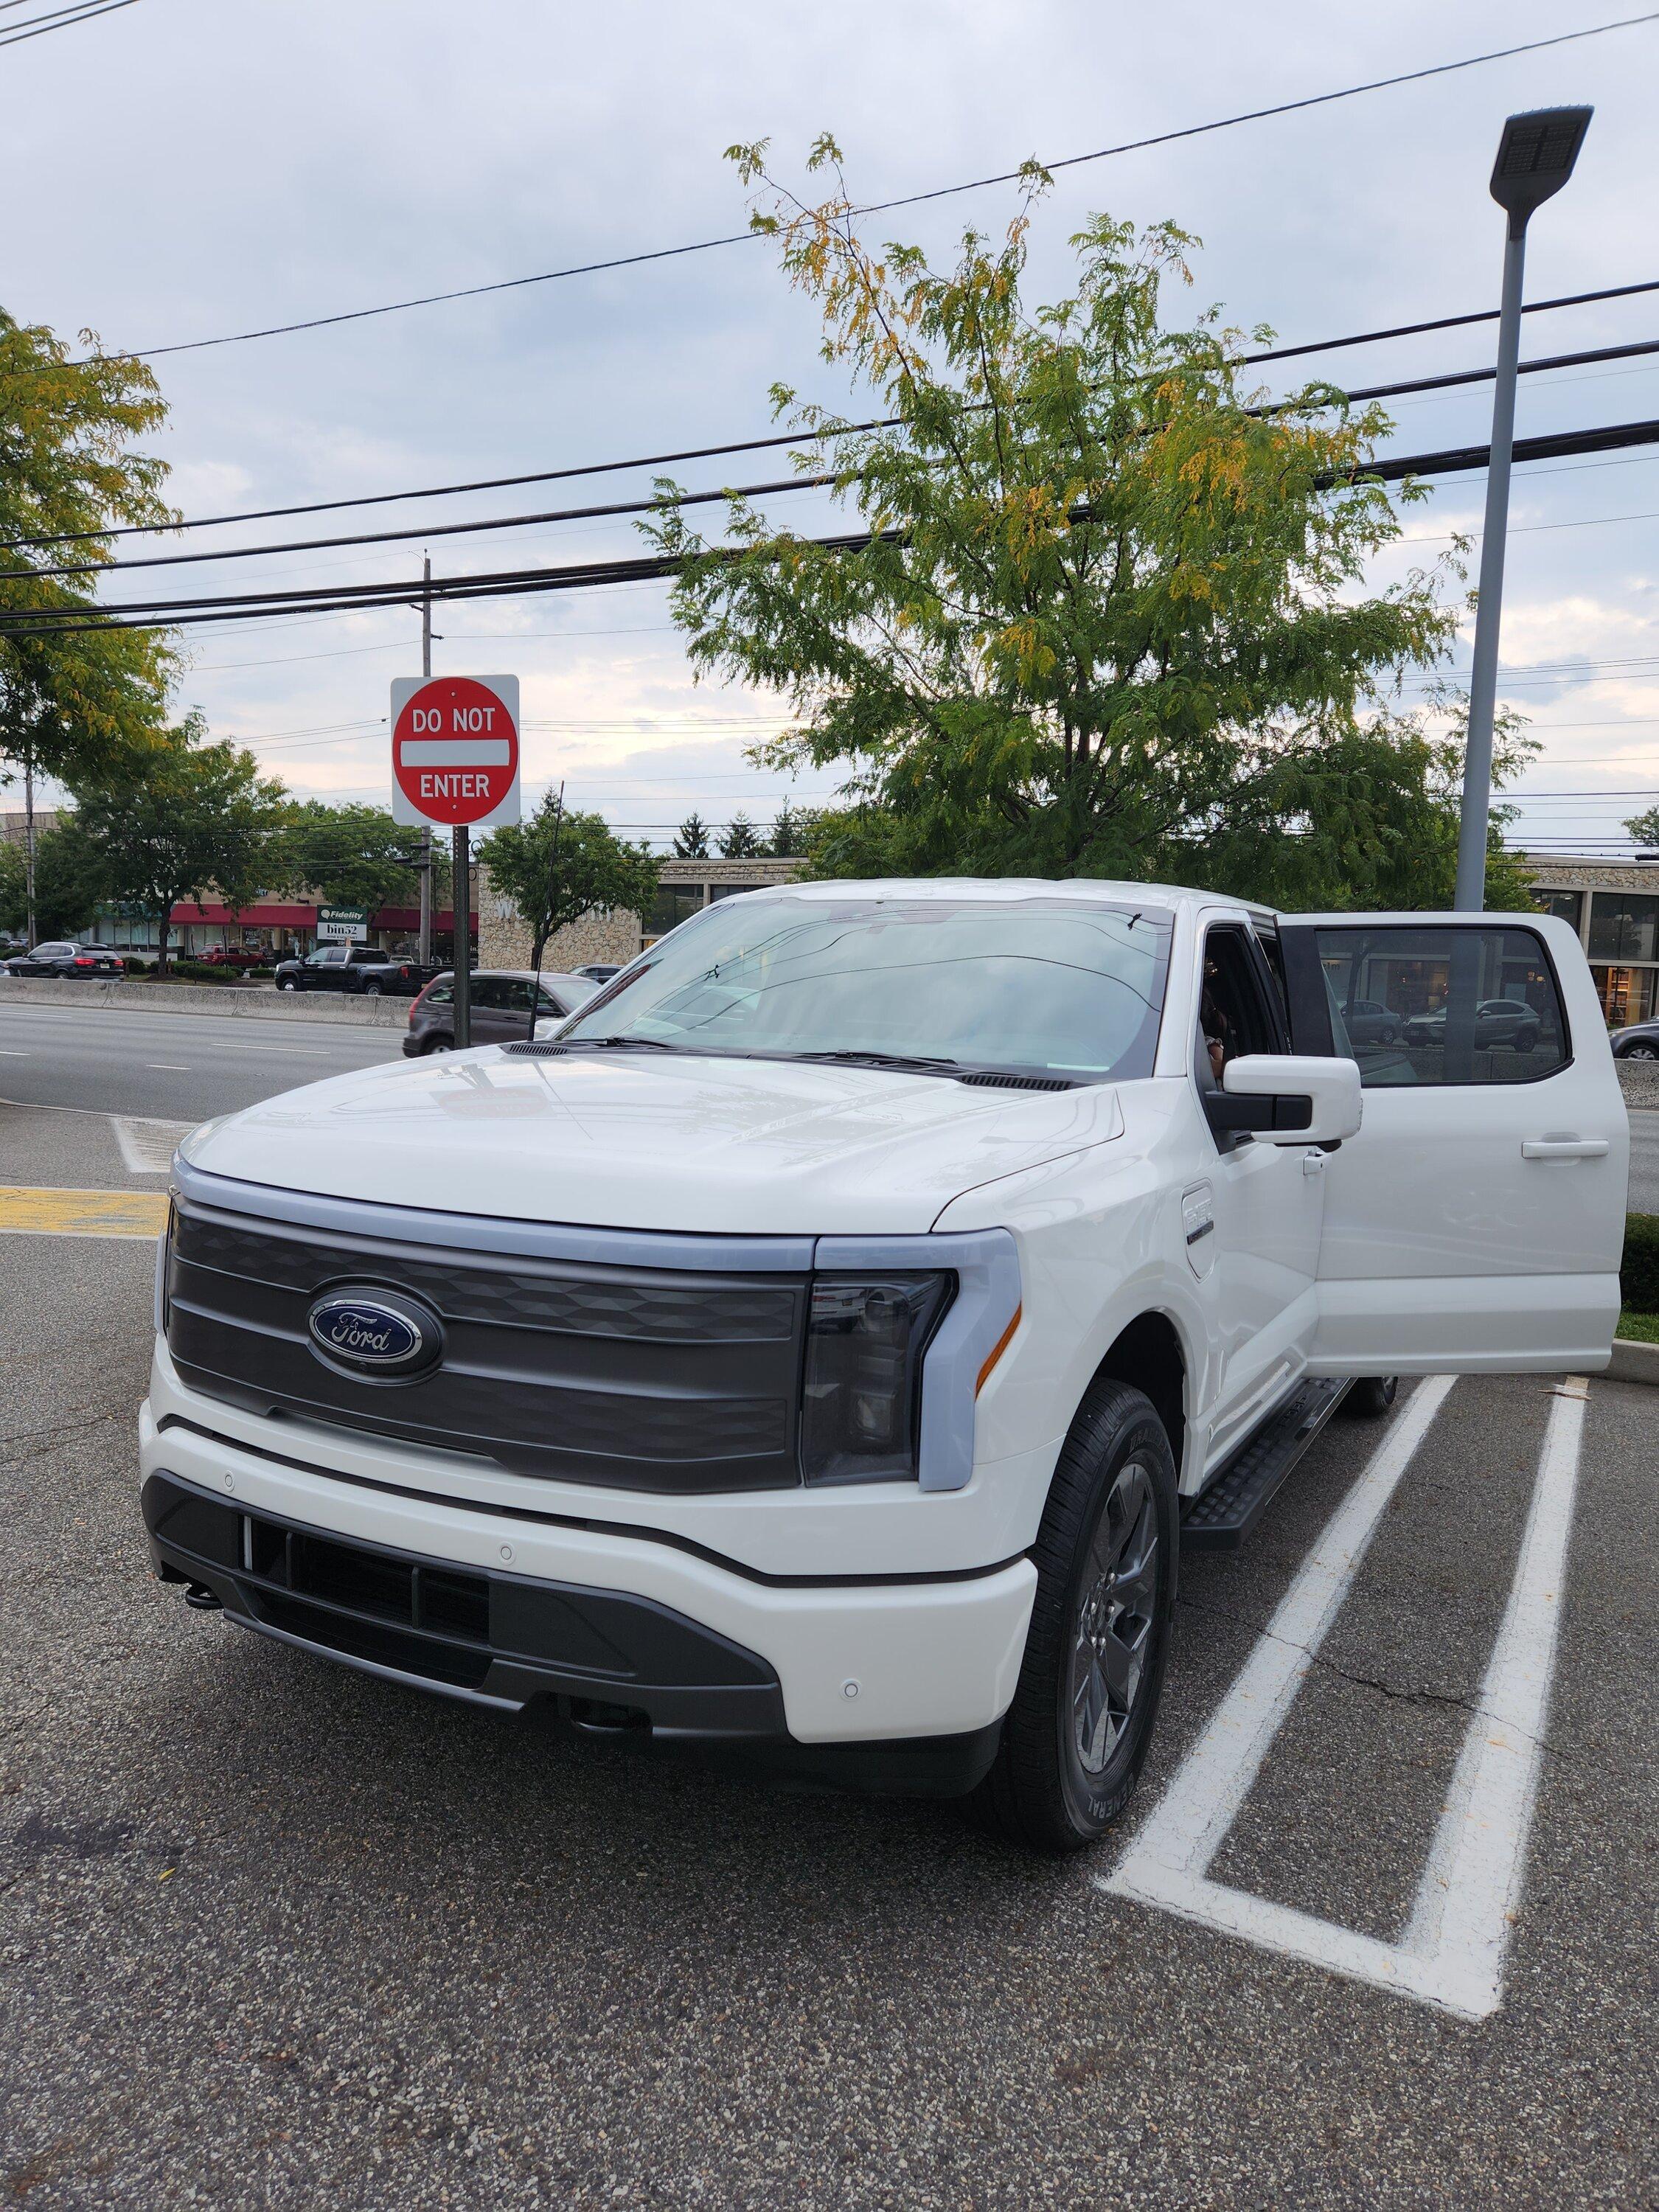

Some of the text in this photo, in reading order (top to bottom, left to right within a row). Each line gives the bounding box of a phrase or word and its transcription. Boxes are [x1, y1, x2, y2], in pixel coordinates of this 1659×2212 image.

[412, 707, 495, 733] DO NOT
[420, 774, 490, 798] ENTER
[330, 911, 364, 920] Fidelity
[327, 924, 357, 935] bin52
[331, 1312, 392, 1352] Ford
